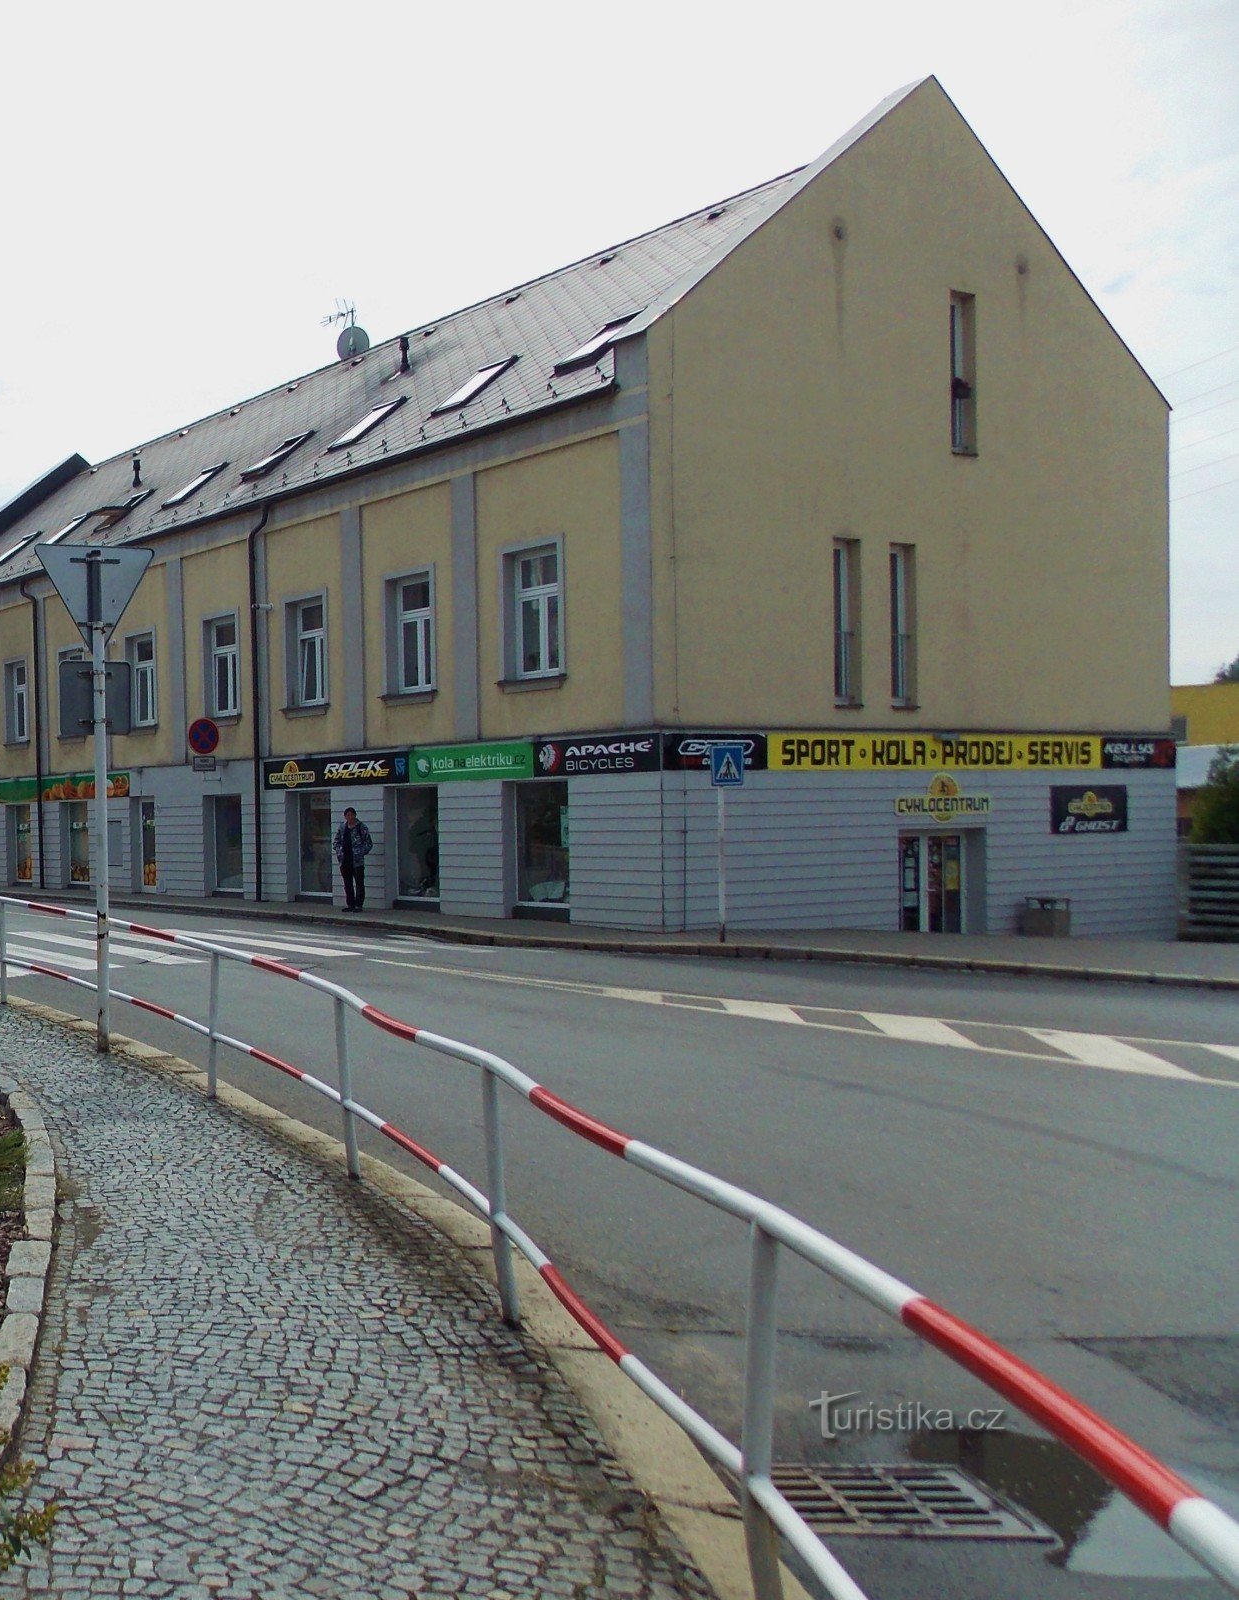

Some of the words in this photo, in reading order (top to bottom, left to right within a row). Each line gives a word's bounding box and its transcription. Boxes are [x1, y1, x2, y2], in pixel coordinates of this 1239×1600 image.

[565, 741, 649, 757] APACHE
[781, 739, 855, 766] SPORT
[871, 740, 926, 766] KOLA
[941, 740, 1012, 765] PRODEJ
[1027, 741, 1092, 765] SERVIS
[323, 759, 387, 775] ROCK
[432, 753, 526, 769] kolanaelektriku.cz
[566, 757, 634, 771] BICYCLES
[324, 768, 390, 780] MACHINE
[897, 797, 990, 813] CYKLOCENTRUM
[1075, 820, 1120, 832] GHOST
